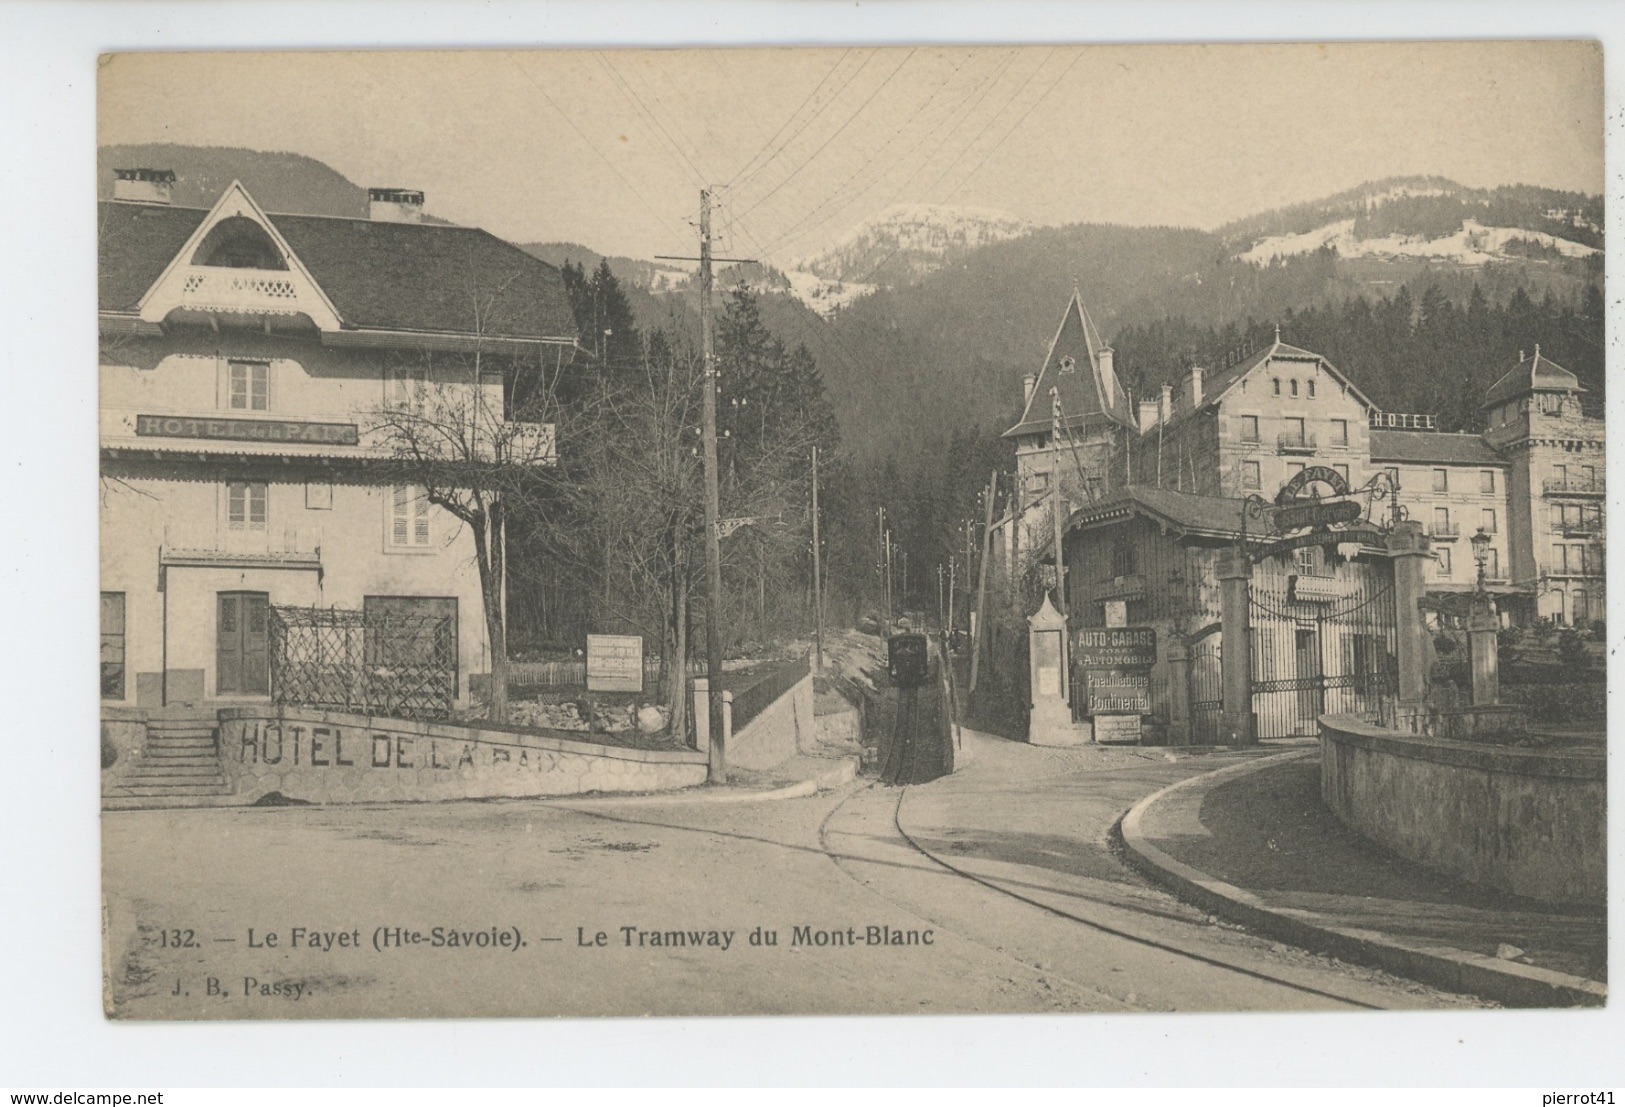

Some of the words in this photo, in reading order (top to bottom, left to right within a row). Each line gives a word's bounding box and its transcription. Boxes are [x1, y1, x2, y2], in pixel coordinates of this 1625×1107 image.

[1375, 413, 1434, 429] HOTEL
[1089, 692, 1150, 711] Continental
[372, 734, 415, 769] DE
[432, 740, 474, 771] LA
[493, 747, 566, 774] PAIX
